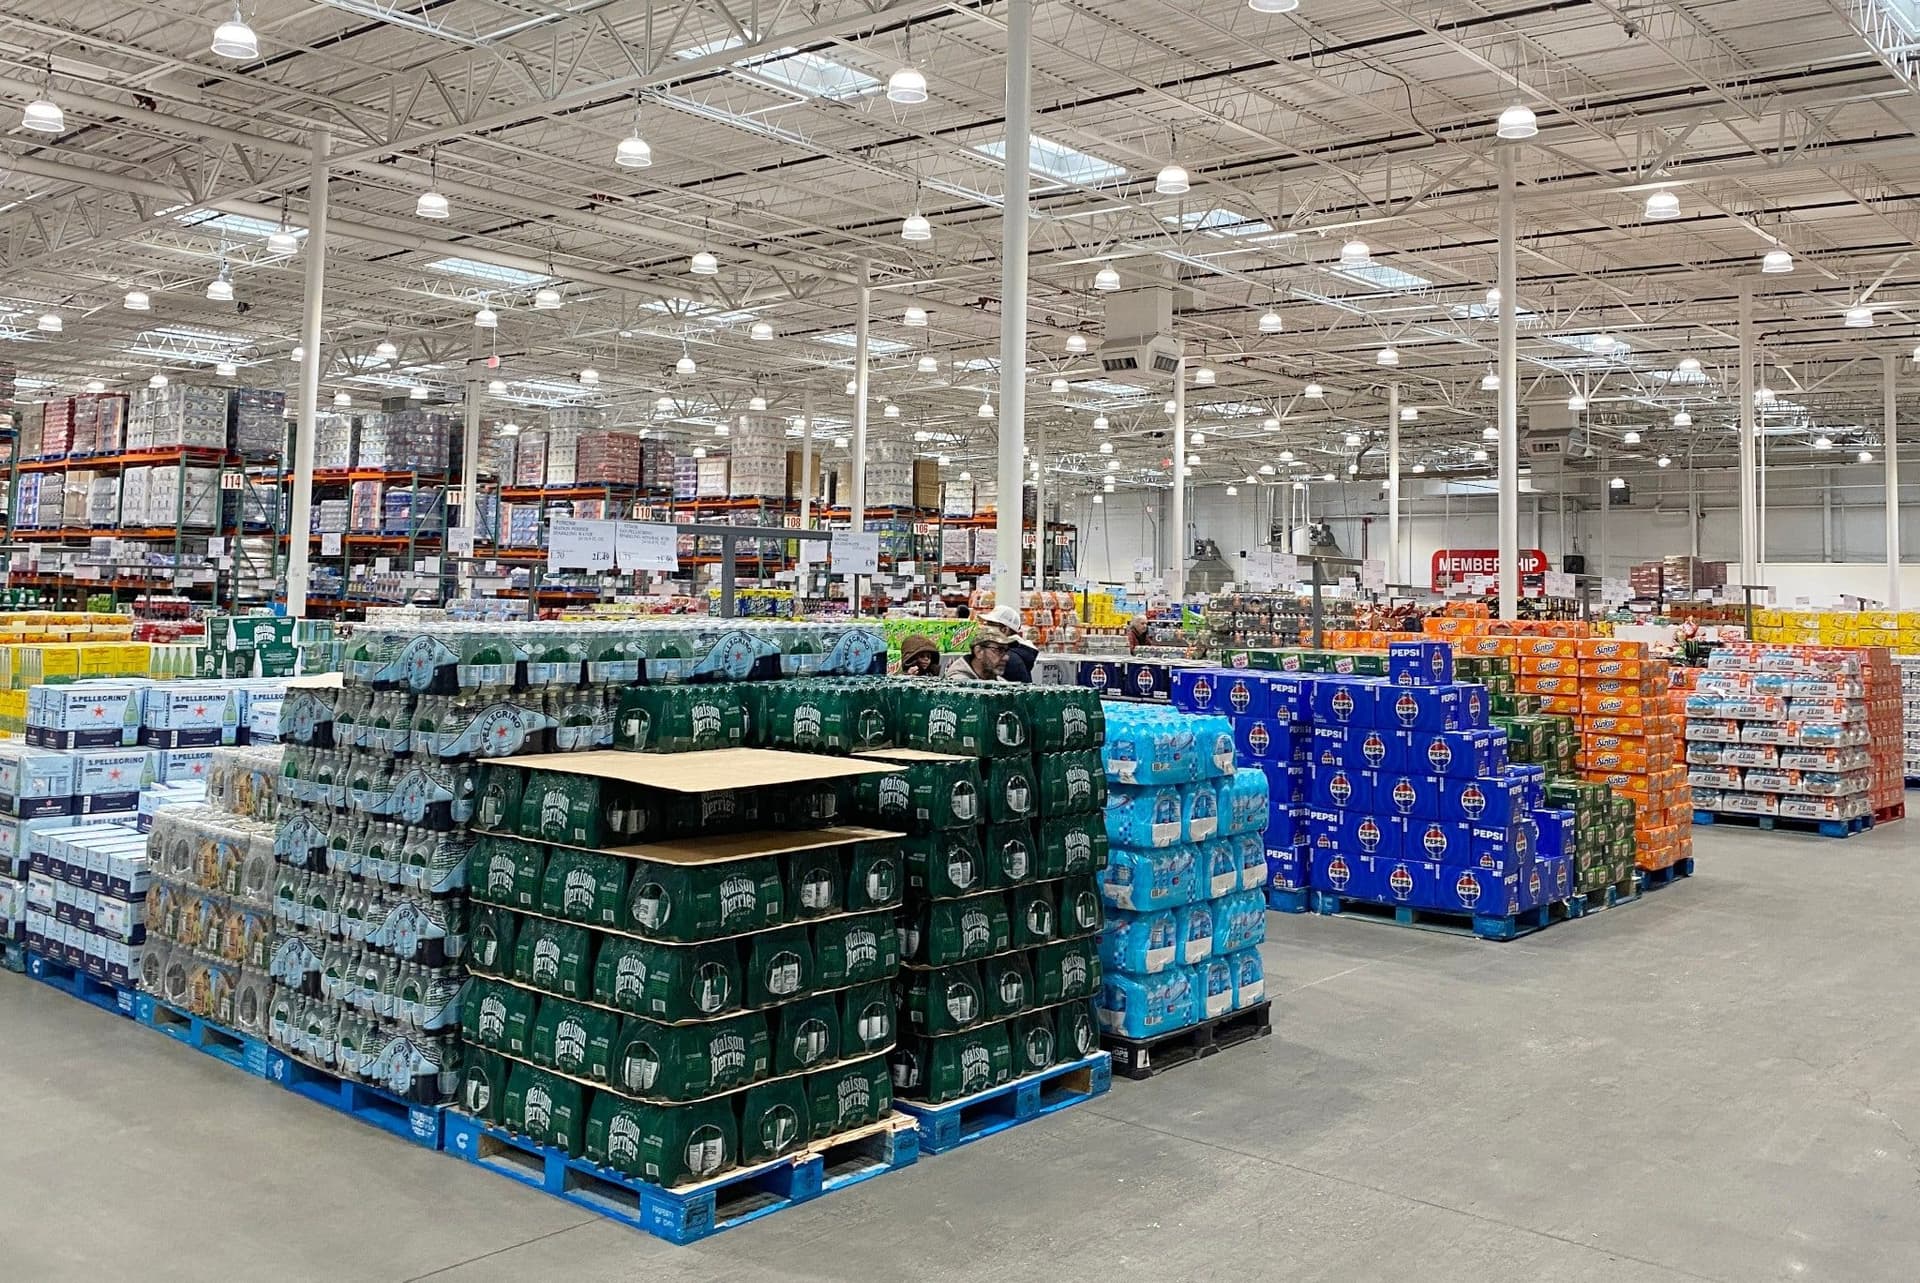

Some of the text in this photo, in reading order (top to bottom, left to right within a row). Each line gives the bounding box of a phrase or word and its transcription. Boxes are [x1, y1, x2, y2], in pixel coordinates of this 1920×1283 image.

[224, 474, 240, 488] 114
[636, 507, 650, 519] 110
[787, 517, 801, 528] 108
[915, 524, 928, 534] 106
[1057, 536, 1068, 545] 102
[1210, 600, 1218, 609] G
[1275, 602, 1283, 610] G
[1236, 620, 1244, 629] G
[1273, 621, 1281, 630] G
[1155, 633, 1162, 642] G
[1210, 638, 1218, 646] G
[1247, 639, 1255, 648] G
[1391, 649, 1420, 658] PEPSI
[1271, 684, 1297, 694] PEPSI
[1334, 701, 1352, 709] PEPSI
[1398, 706, 1416, 714] PEPSI
[692, 704, 721, 722] Maison
[794, 704, 821, 723] Maison
[930, 707, 957, 725] Maison
[1315, 728, 1342, 739] PEPSI
[1430, 751, 1449, 759] PEPSI
[879, 773, 909, 794] Maison
[1332, 785, 1350, 793] PEPSI
[542, 789, 570, 811] Maison
[1395, 791, 1413, 800] PEPSI
[1311, 812, 1337, 823] PEPSI
[1360, 831, 1378, 839] PEPSI
[1473, 828, 1504, 841] PEPSI
[1426, 838, 1445, 846] PEPSI
[1267, 850, 1293, 861] PEPSI
[489, 853, 516, 875] Maison
[566, 866, 596, 892] Maison
[1392, 878, 1411, 887] PEPSI
[720, 876, 756, 900] Maison
[1458, 887, 1478, 895] PEPSI
[844, 928, 876, 951] Maison
[535, 937, 561, 960] Maison
[617, 955, 647, 979] Maison
[481, 996, 507, 1018] Maison
[558, 1019, 587, 1044] Maison
[710, 1034, 745, 1057] Maison
[961, 1046, 990, 1066] Maison
[838, 1077, 869, 1097] Maison
[526, 1087, 553, 1113] Maison
[611, 1115, 641, 1142] Maison
